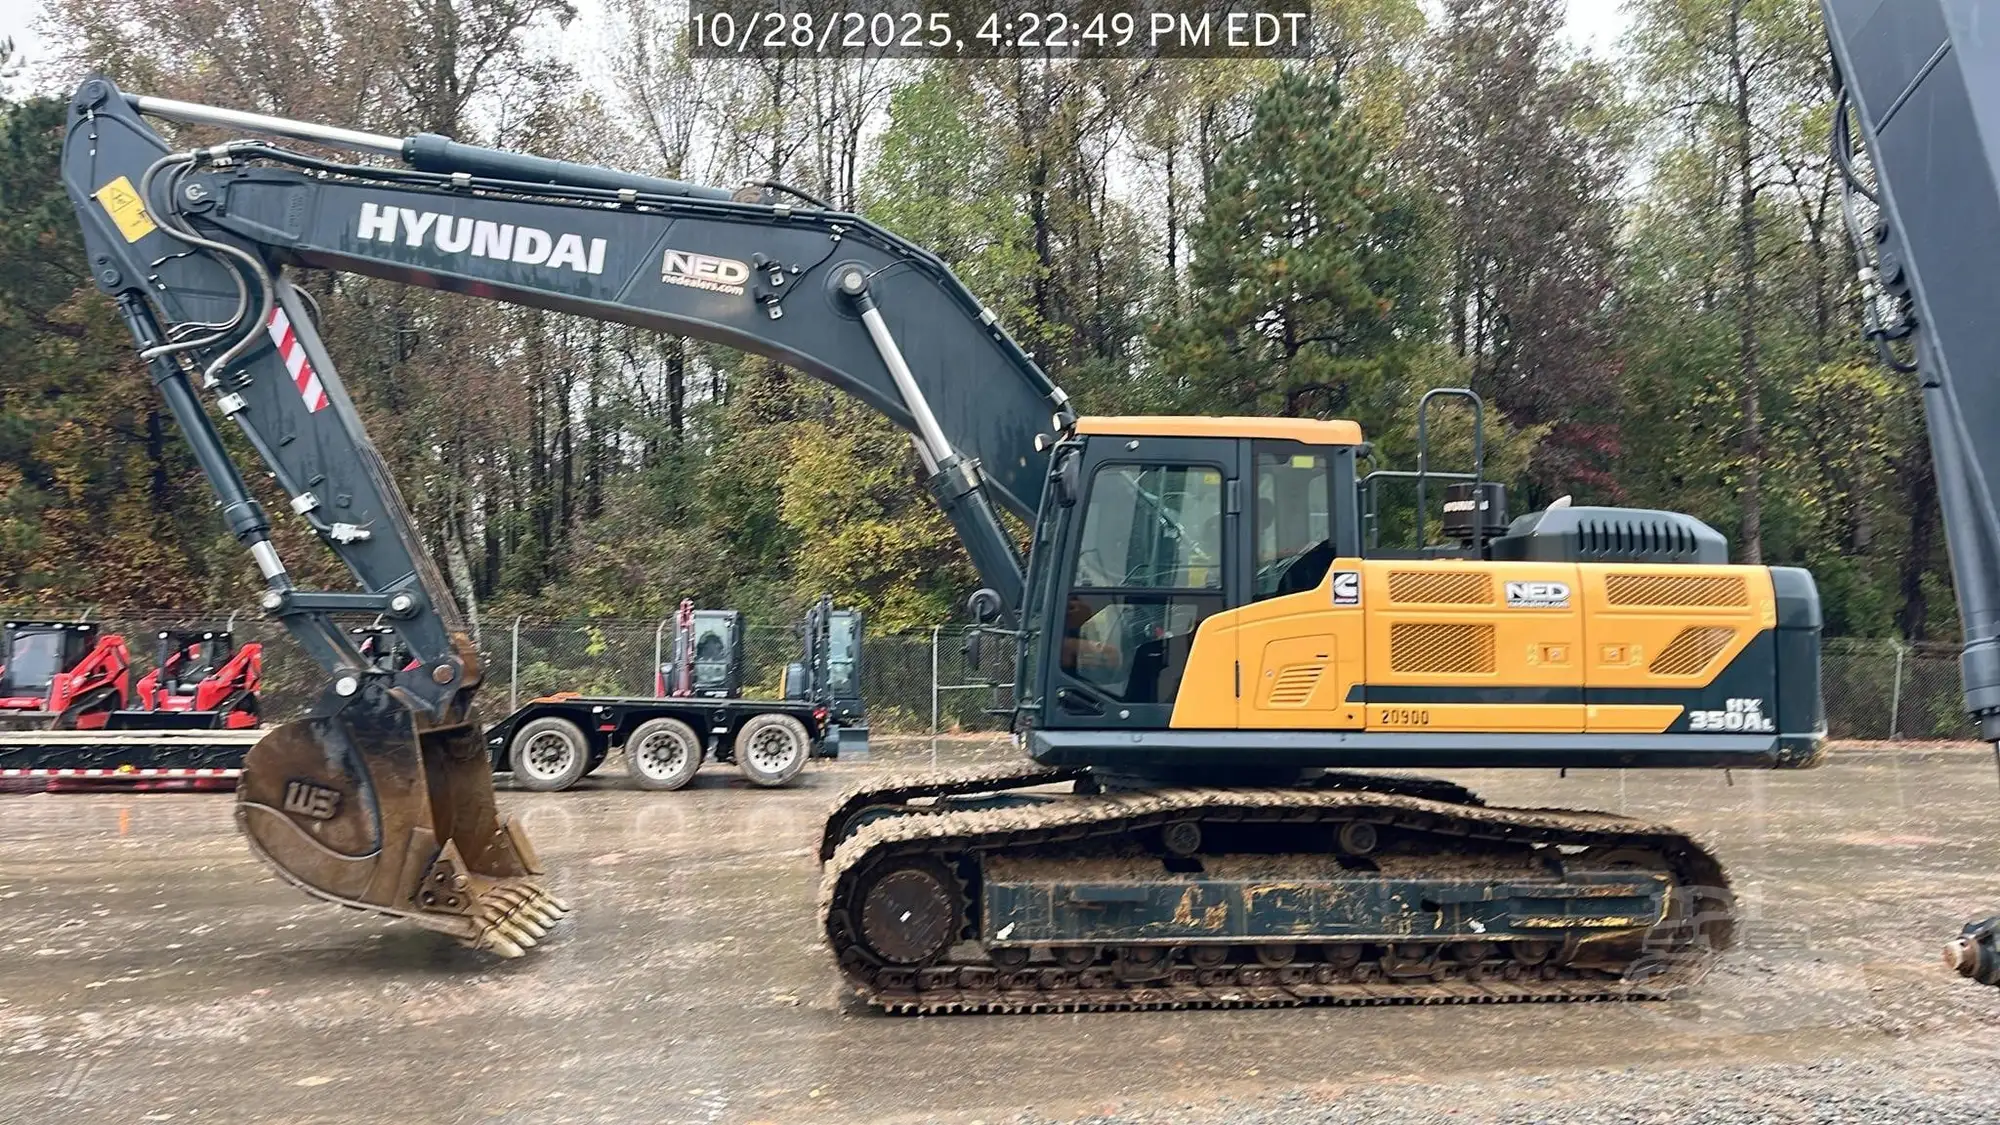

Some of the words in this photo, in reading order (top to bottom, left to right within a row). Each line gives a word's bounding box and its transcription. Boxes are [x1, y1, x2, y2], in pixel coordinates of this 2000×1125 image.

[357, 202, 607, 275] HYUNDAI
[662, 249, 750, 286] NED
[1505, 581, 1571, 602] NED
[1381, 709, 1430, 725] 20900
